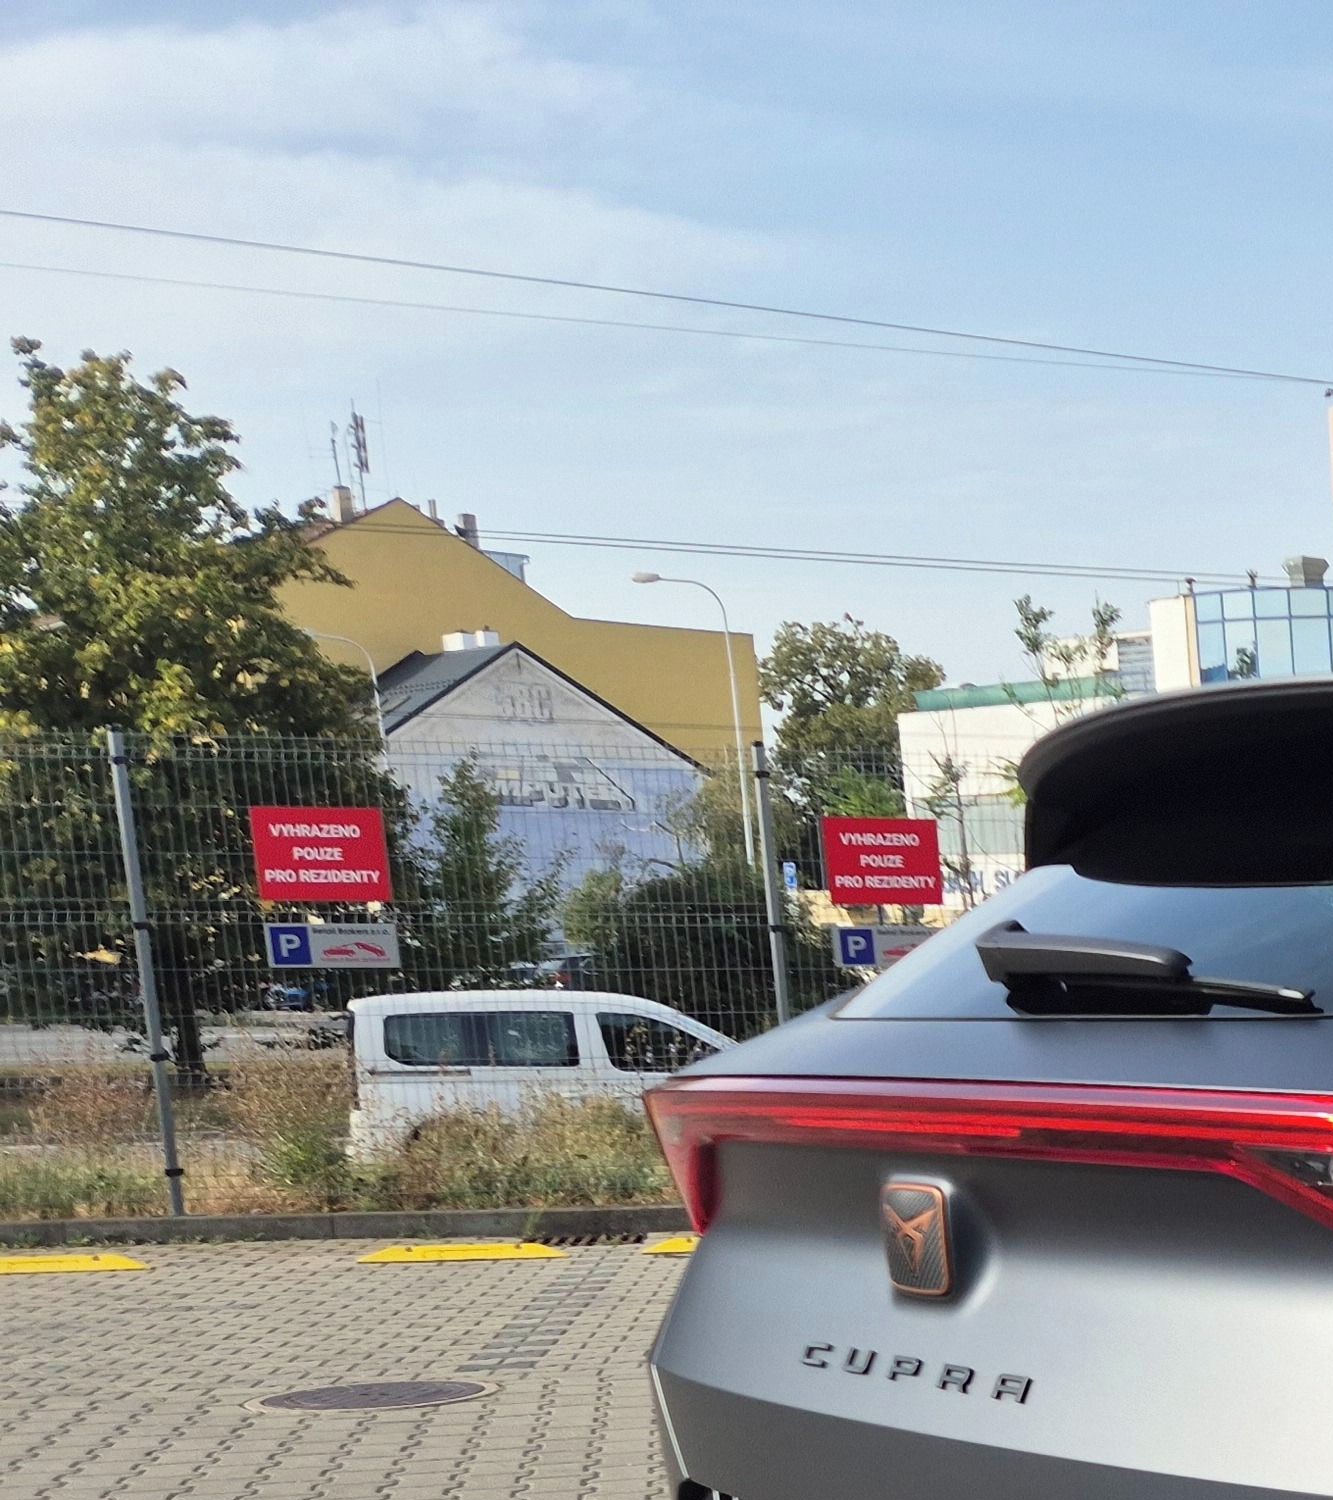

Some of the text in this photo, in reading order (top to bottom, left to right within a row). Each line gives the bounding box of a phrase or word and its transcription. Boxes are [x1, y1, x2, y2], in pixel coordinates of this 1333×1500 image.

[487, 779, 636, 813] MPUTER
[268, 823, 361, 838] VYHRAZENO
[839, 832, 920, 847] VYHRAZENO
[292, 847, 344, 861] POUZE
[860, 854, 905, 868] POUZE
[264, 869, 380, 884] PRO REZIDENTY
[835, 875, 863, 888] PRO
[864, 875, 936, 889] REZIDENTY
[278, 933, 301, 958] P
[846, 935, 867, 959] P
[801, 1341, 1034, 1405] CUPRA
